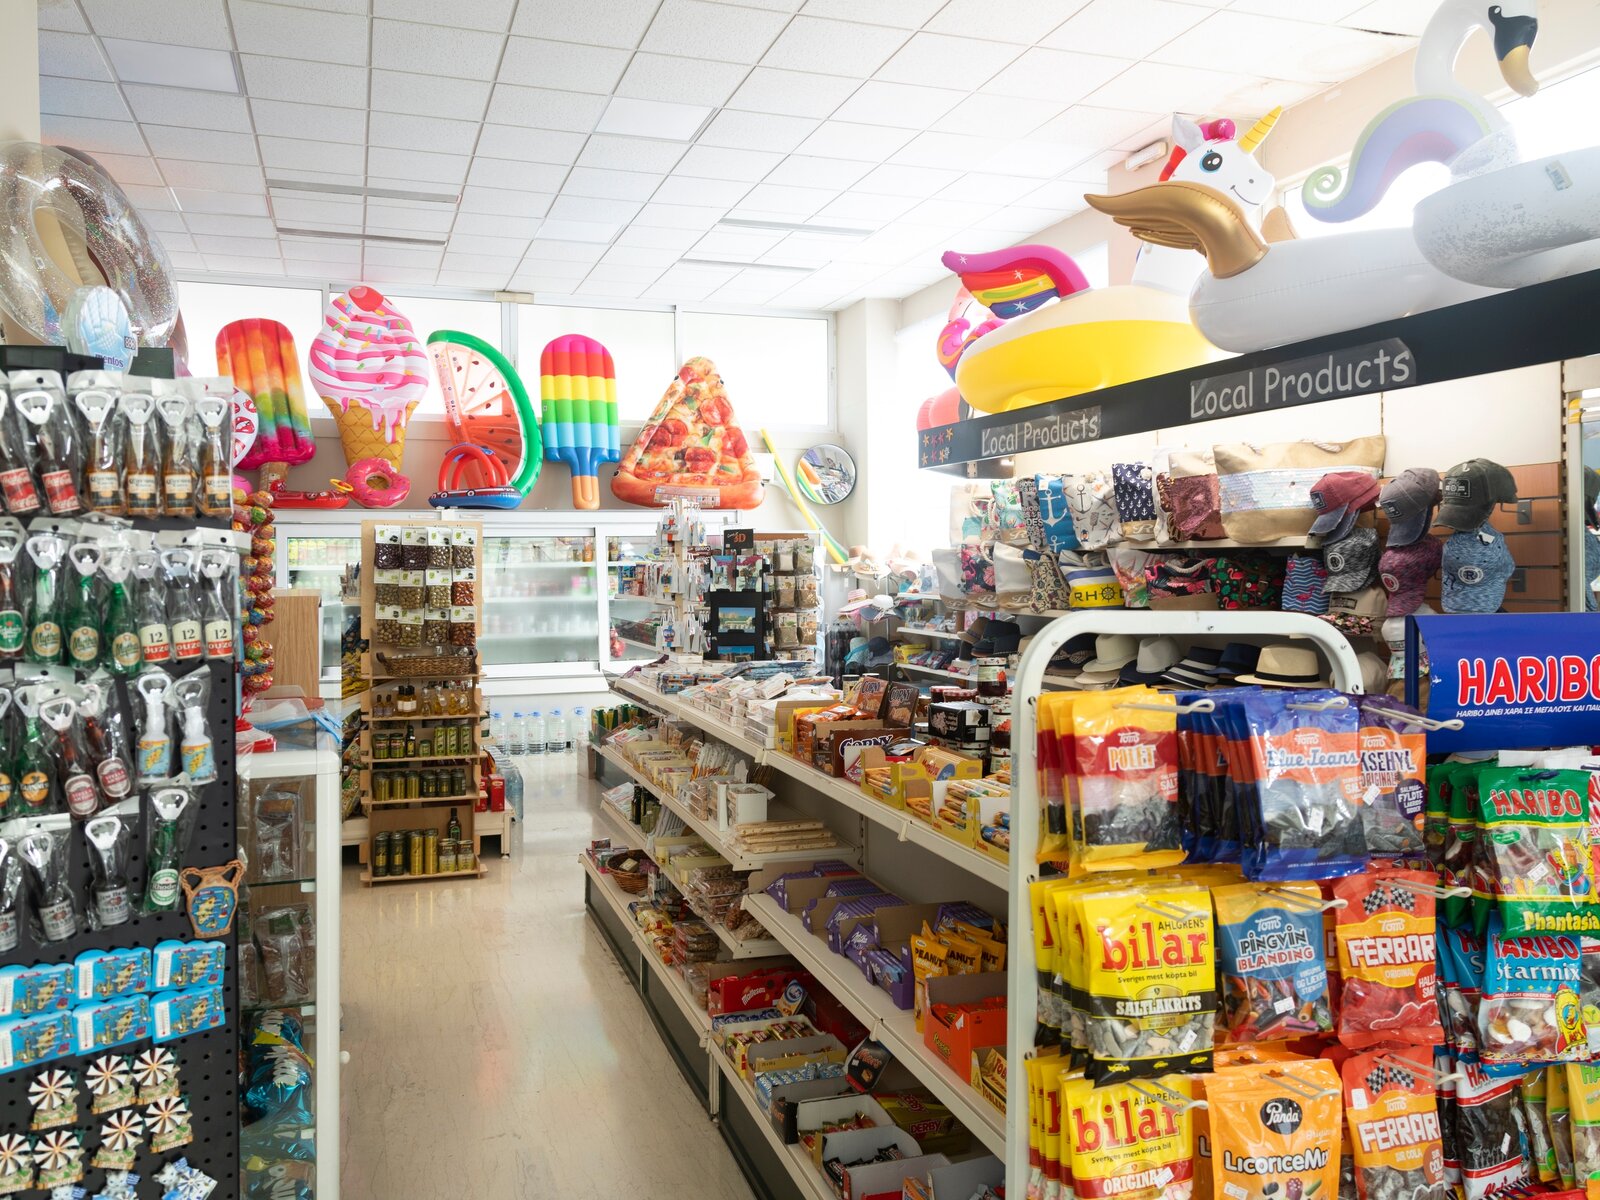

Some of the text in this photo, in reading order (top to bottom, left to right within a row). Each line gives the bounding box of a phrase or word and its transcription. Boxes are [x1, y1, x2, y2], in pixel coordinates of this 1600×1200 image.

[1190, 348, 1411, 419] Local Products
[981, 413, 1099, 456] Local Products
[150, 632, 163, 643] 12
[182, 629, 195, 640] 12
[214, 628, 228, 640] 12
[1456, 710, 1484, 718] HARIBO
[1504, 707, 1523, 716] ΧΑΡΑ
[1524, 706, 1534, 714] ΣΕ
[1117, 731, 1140, 744] Toms
[1266, 747, 1361, 769] Blue Jeans
[1490, 789, 1583, 817] HARIBO
[1158, 919, 1205, 931] AHLGRENS
[1254, 915, 1282, 932] Toms
[1523, 911, 1600, 931] Phantasia
[1096, 921, 1208, 972] bilar
[1347, 934, 1436, 967] FERRAR
[948, 949, 976, 966] ANUT
[1236, 946, 1314, 973] BLANDING
[1118, 976, 1145, 984] Sveriges
[1384, 967, 1415, 979] ORIGINAL
[1496, 962, 1581, 981] Starmix
[1115, 996, 1202, 1017] SALTLAKRITS
[1266, 1102, 1300, 1126] Panda
[910, 1120, 941, 1134] DERBY
[1072, 1099, 1184, 1155] bilar
[1123, 1150, 1141, 1158] mest
[1103, 1168, 1163, 1195] ORIGINA
